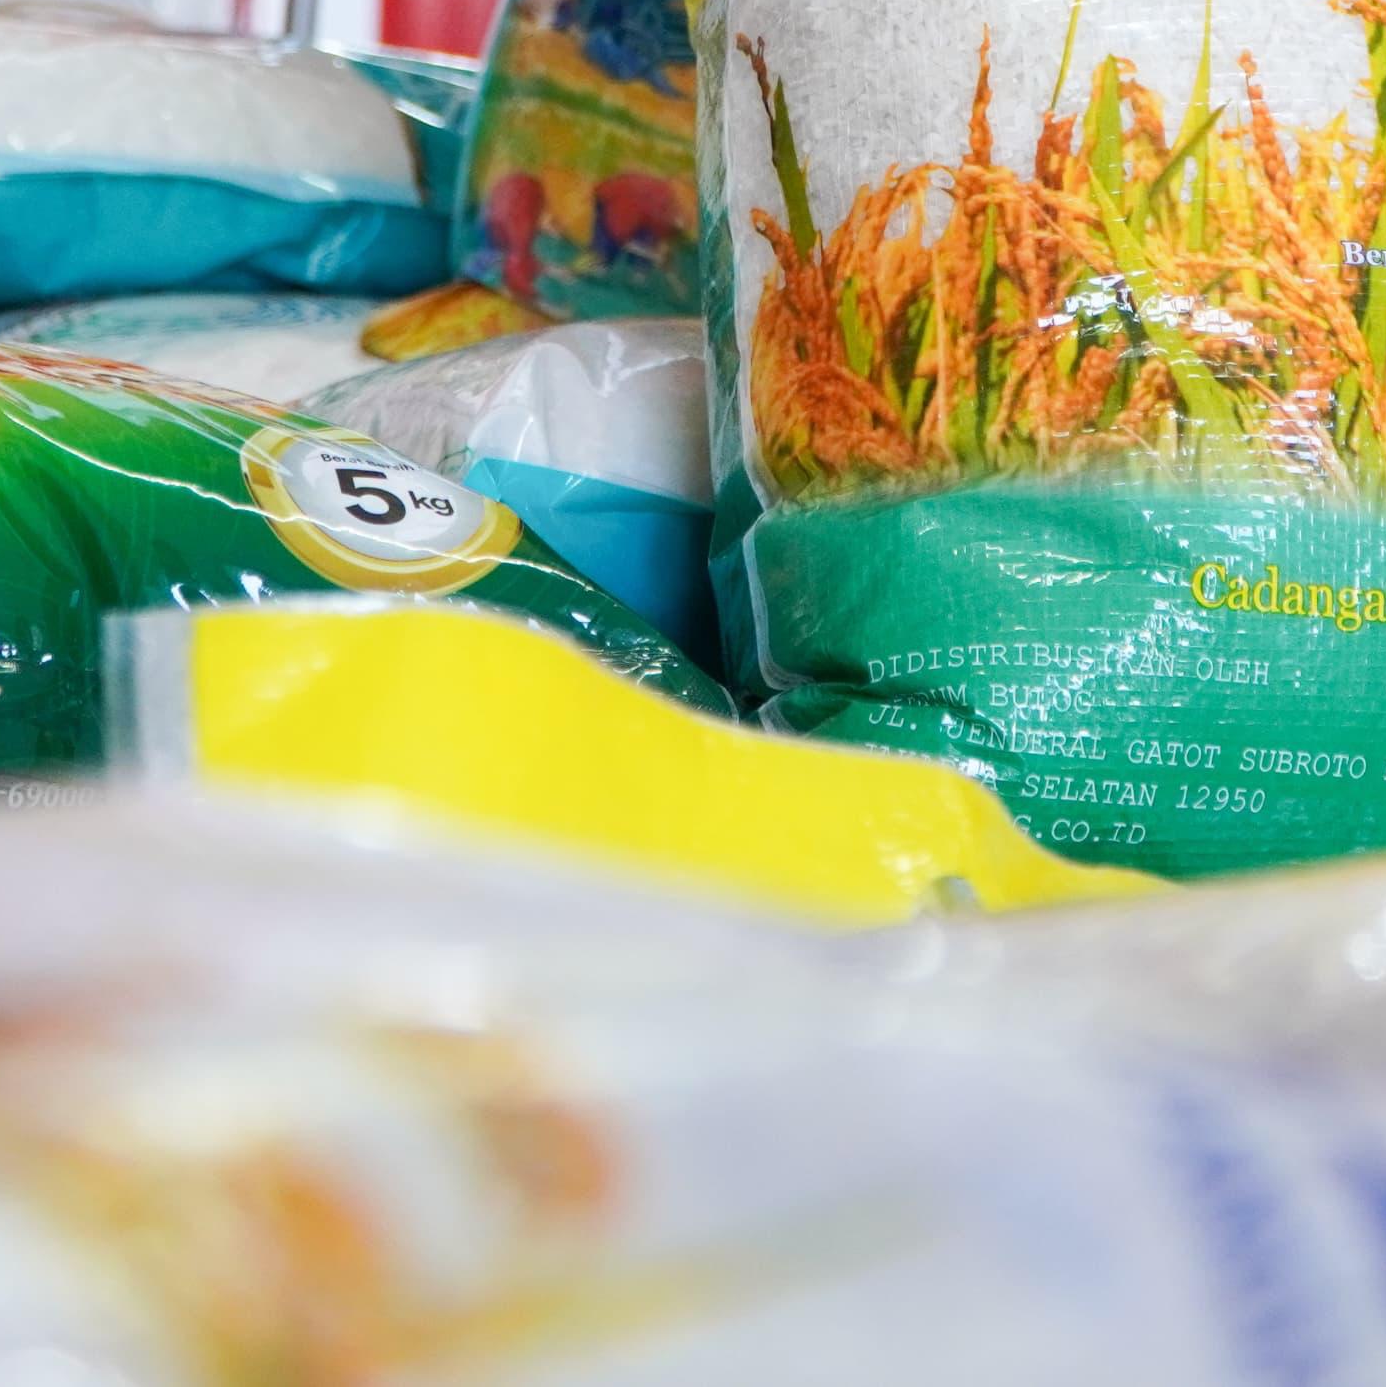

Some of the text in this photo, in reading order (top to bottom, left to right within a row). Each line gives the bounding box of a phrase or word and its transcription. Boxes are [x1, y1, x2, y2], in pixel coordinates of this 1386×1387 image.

[868, 643, 1176, 683] DIDISTRIBUSIKAN
[1196, 657, 1270, 685] OLEH
[868, 704, 918, 731] JL.
[945, 716, 1106, 760] JENDERAL
[1128, 740, 1221, 769] GATOT
[1239, 748, 1366, 779] SUBROTO
[1021, 774, 1266, 814] SELATAN 12950
